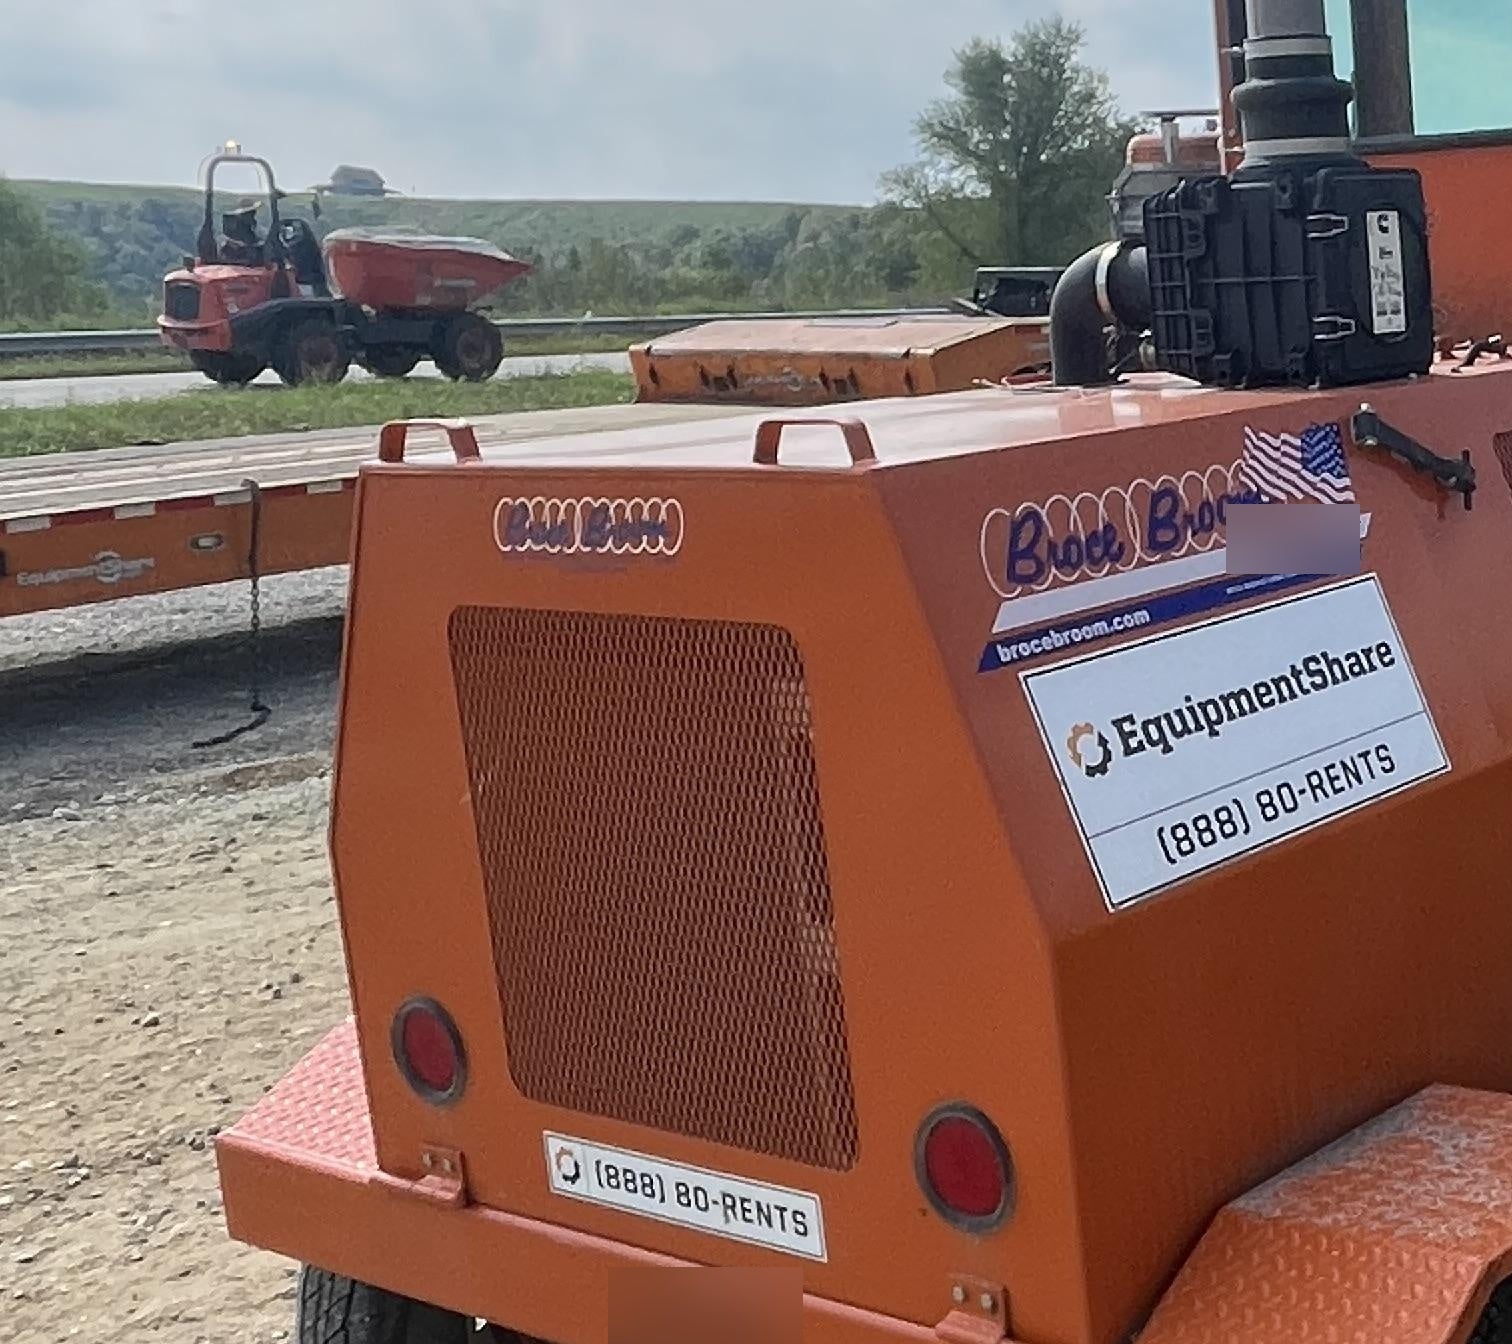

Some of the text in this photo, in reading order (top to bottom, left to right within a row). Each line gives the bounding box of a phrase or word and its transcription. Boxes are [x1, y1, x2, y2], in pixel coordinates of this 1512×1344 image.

[1007, 486, 1262, 585] Broce Bro
[996, 607, 1151, 663] brocebroom.com
[1110, 639, 1396, 758] EquipmentShare
[1157, 743, 1396, 865] (888) 80-RENTS
[594, 1159, 809, 1238] (888) 80-RENTS
